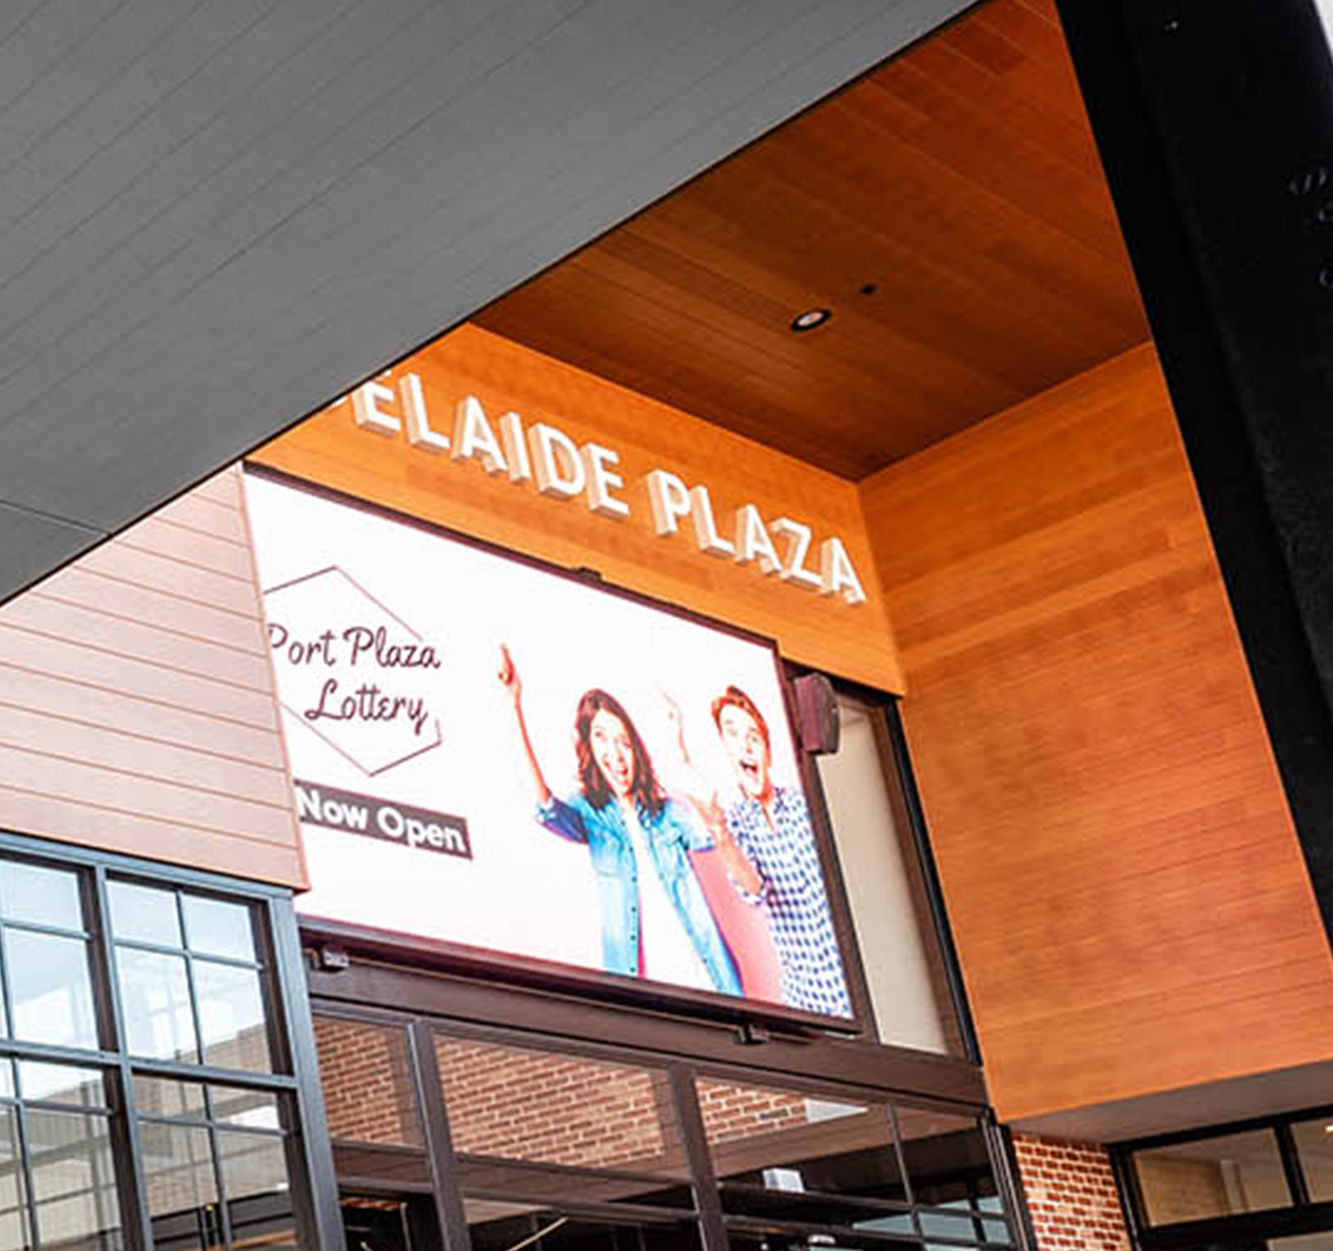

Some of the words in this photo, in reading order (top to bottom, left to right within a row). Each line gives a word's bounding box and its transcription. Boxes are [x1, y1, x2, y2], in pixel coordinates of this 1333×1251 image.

[333, 369, 629, 519] ELAIDE
[647, 469, 867, 604] PLAZA
[343, 625, 441, 669] Plaza
[304, 678, 429, 736] Lottery
[295, 786, 369, 831] Now
[376, 806, 465, 850] Open
